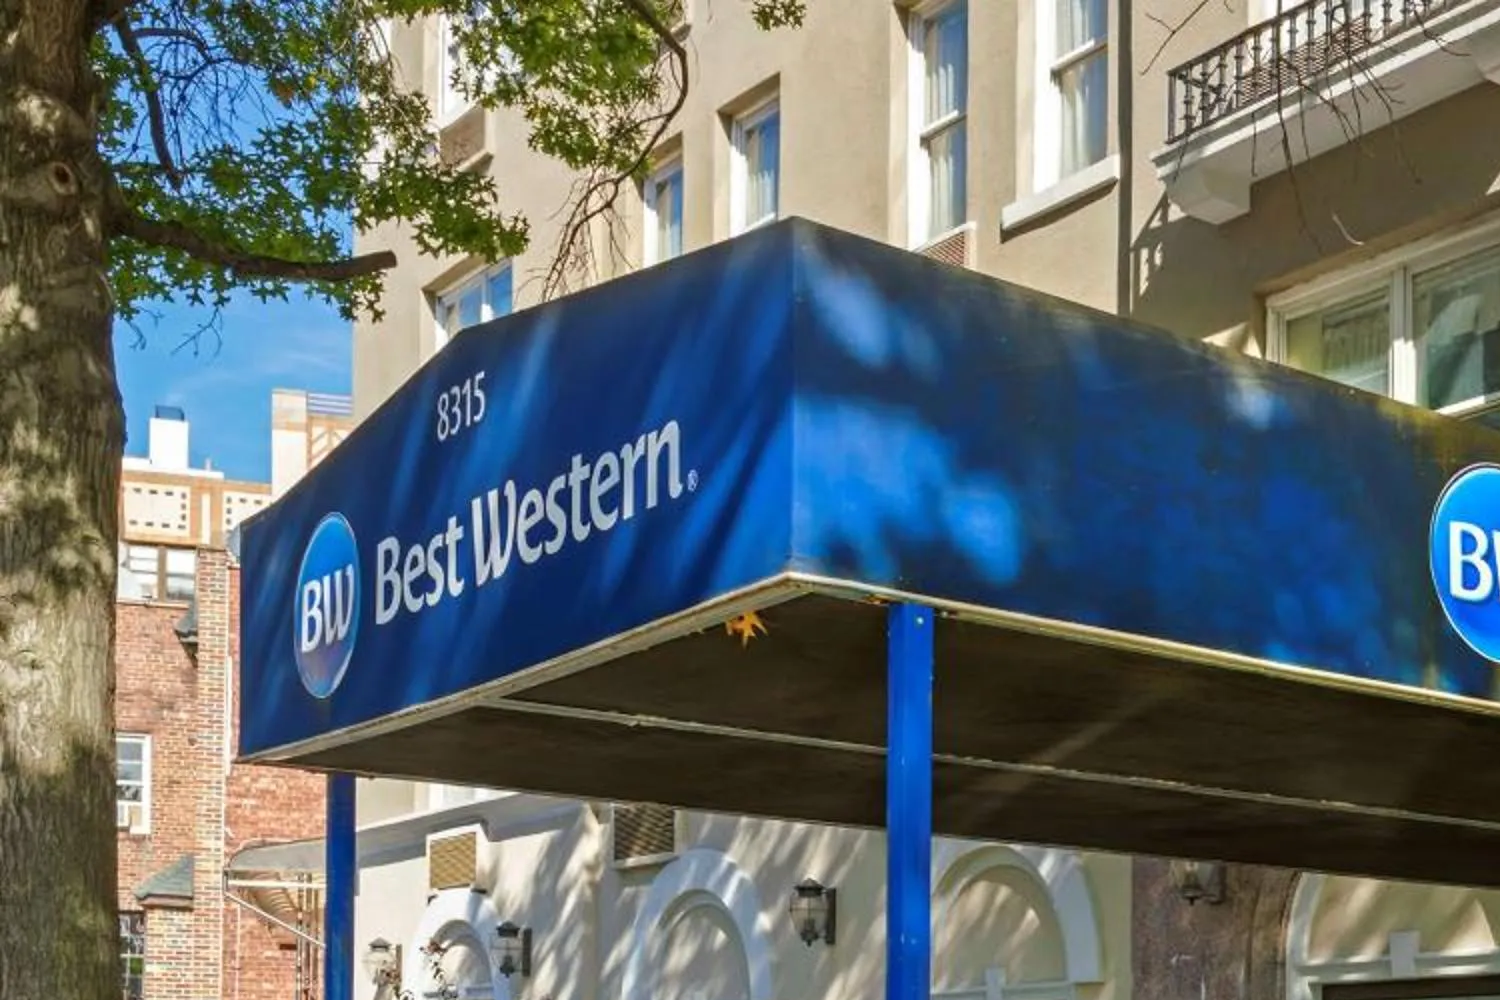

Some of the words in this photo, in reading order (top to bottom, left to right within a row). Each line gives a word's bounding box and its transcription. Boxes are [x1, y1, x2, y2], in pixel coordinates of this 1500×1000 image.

[436, 370, 486, 441] 8315
[300, 564, 355, 655] BW
[375, 515, 465, 626] Best
